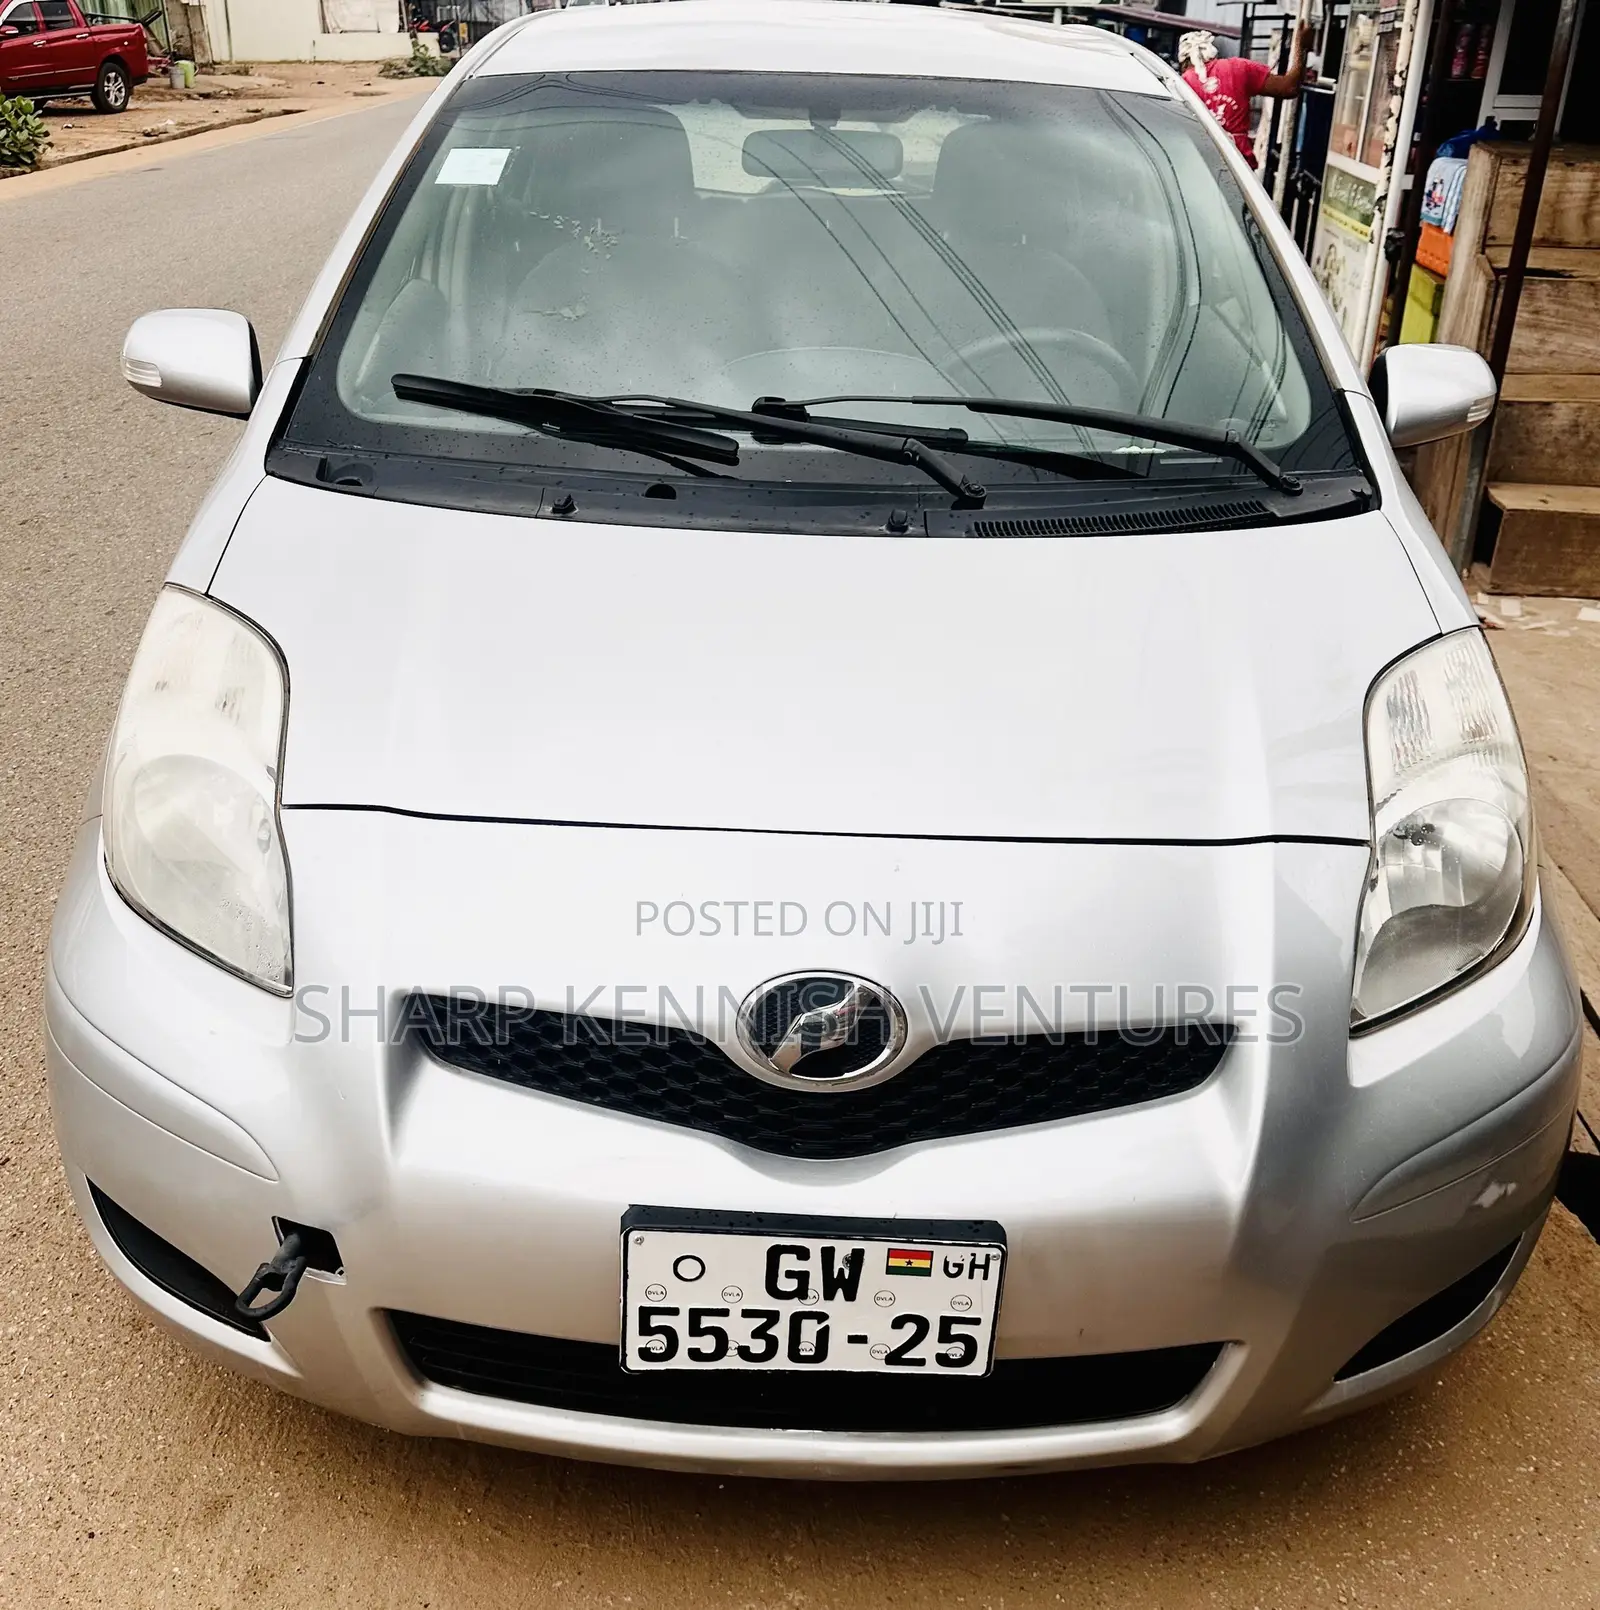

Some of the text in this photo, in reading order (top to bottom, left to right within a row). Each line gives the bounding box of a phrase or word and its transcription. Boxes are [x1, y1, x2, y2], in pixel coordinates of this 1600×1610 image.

[765, 1244, 866, 1302] GW
[942, 1252, 991, 1281] GH
[637, 1304, 983, 1368] 5530-25
